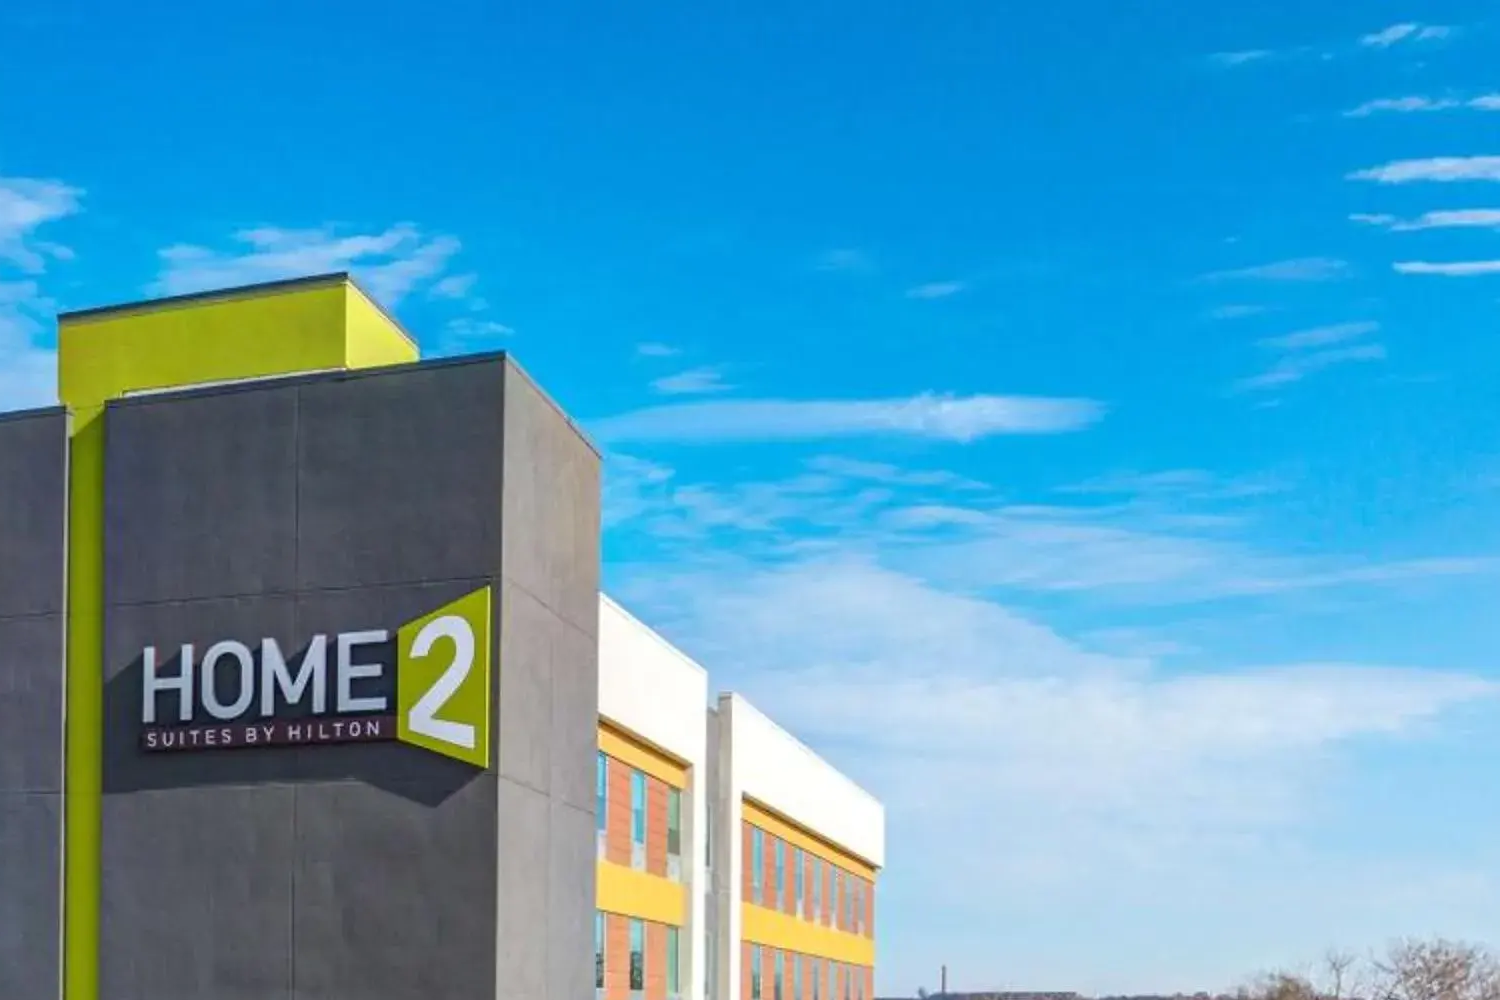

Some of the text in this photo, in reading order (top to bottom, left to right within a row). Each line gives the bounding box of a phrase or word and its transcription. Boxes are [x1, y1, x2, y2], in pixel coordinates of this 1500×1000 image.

[141, 629, 389, 724] HOME
[146, 720, 381, 748] SUITES BY HILTON
